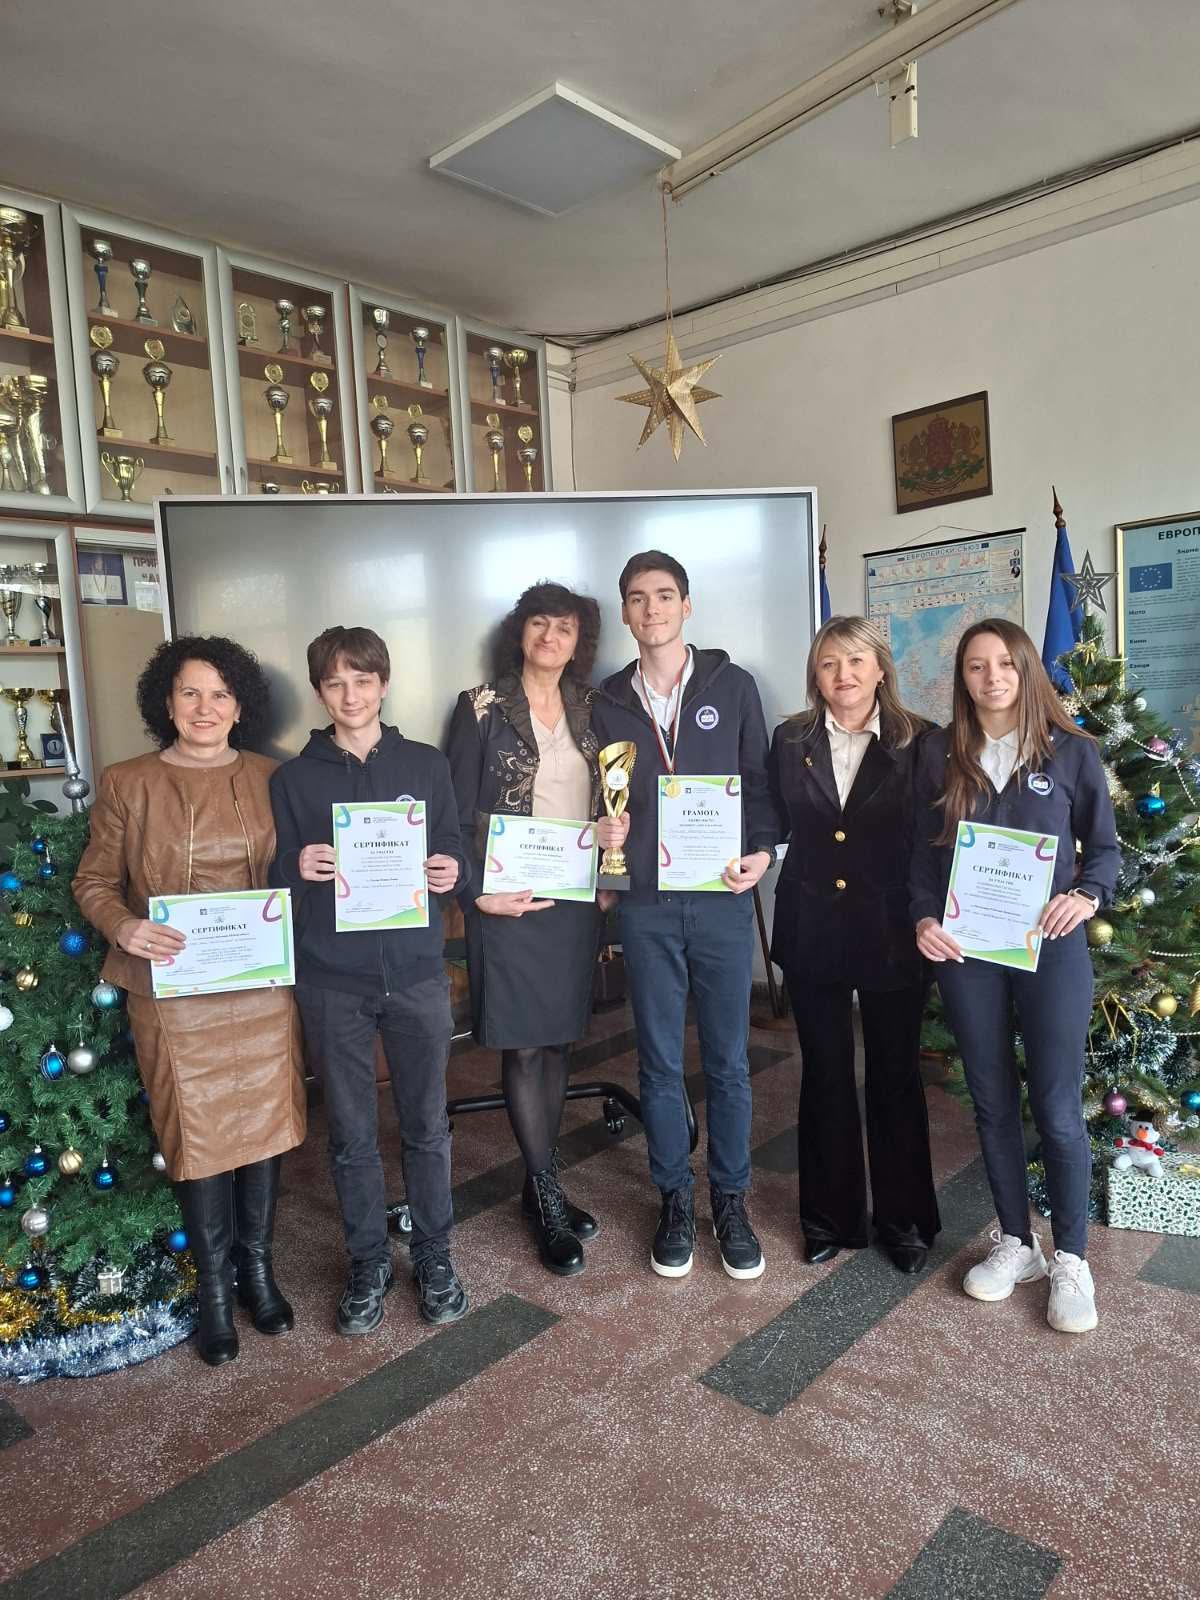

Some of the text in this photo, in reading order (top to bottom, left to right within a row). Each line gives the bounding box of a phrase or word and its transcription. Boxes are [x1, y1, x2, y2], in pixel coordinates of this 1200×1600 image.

[1158, 526, 1200, 540] ЕВРОП
[906, 548, 955, 561] ЕВРОПЕЙСКИ
[957, 543, 980, 553] СЪЮЗ
[682, 809, 720, 817] ГРАМОТА
[352, 840, 409, 849] СЕРТИФИКАТ
[519, 843, 565, 852] СЕРТИФИКАТ
[972, 864, 1034, 882] СЕРТИФИКАТ
[191, 923, 248, 935] СЕРТИФИКАТ
